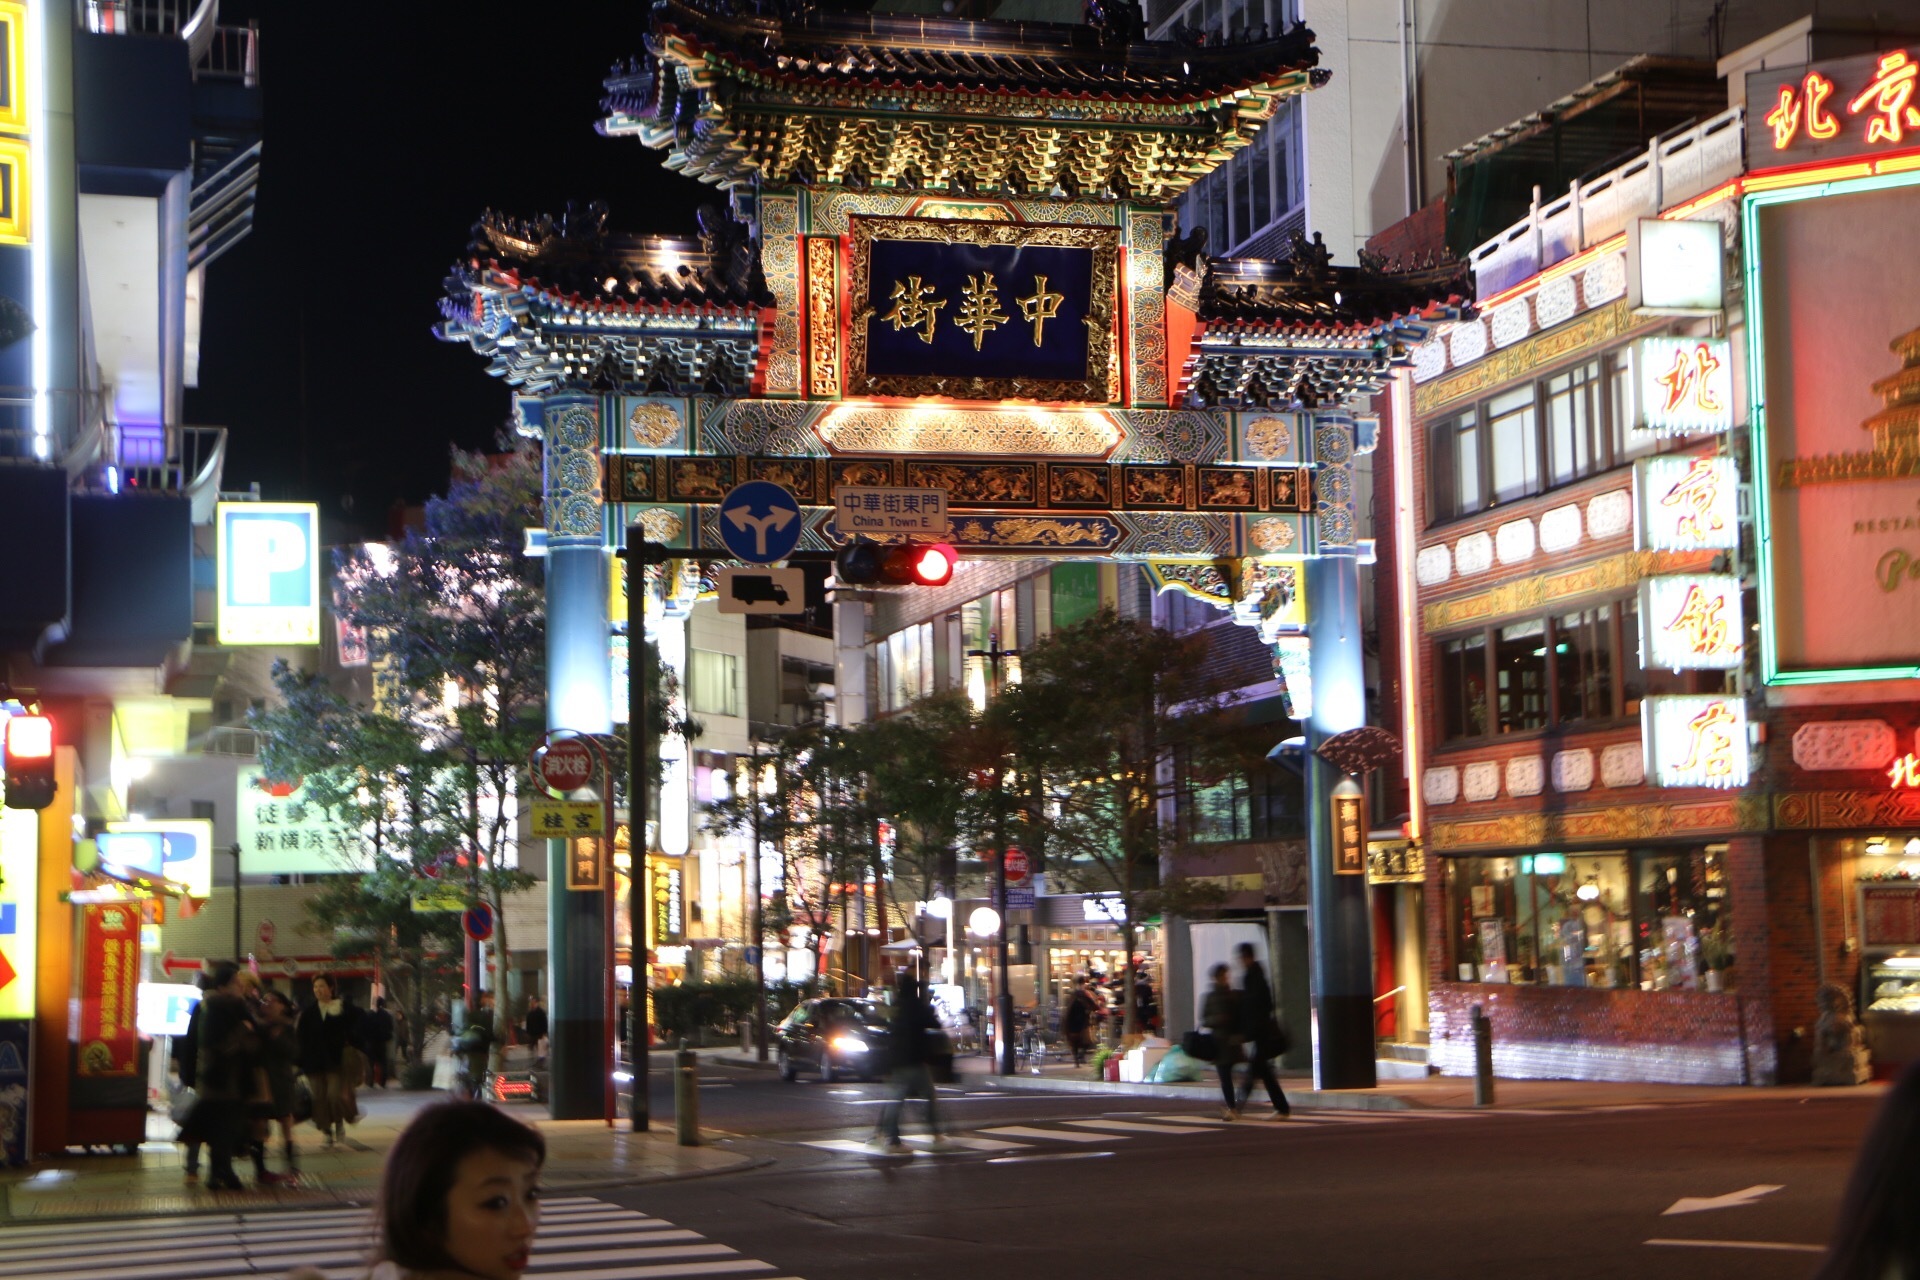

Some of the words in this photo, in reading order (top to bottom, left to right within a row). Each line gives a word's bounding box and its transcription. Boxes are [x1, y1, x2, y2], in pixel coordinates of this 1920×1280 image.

[880, 271, 1065, 351] 中華街
[844, 493, 939, 514] 中華街東門
[852, 515, 883, 526] China
[889, 516, 917, 527] Town
[1854, 517, 1920, 534] RESTA
[232, 520, 306, 604] P
[545, 755, 588, 775] 消火栓
[541, 812, 594, 828] 桂宮
